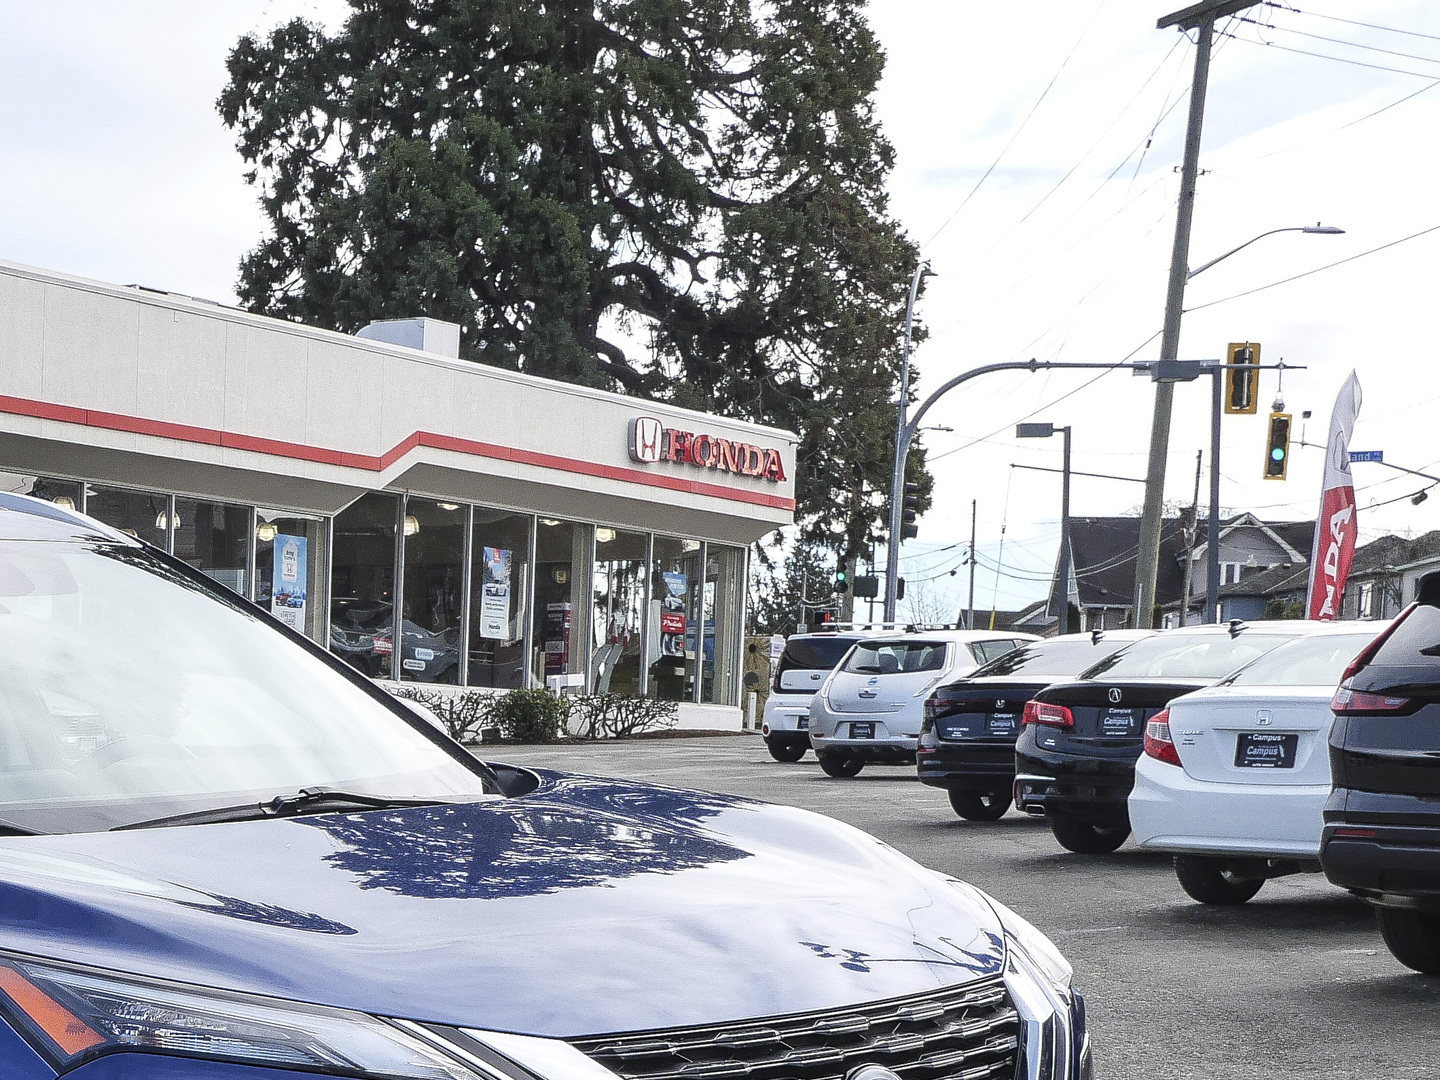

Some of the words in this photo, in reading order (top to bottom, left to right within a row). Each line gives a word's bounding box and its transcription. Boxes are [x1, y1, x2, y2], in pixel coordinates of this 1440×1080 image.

[666, 428, 788, 482] HONDA
[1318, 503, 1355, 621] NDA
[1246, 745, 1279, 757] Campus
[1252, 733, 1282, 742] Campus
